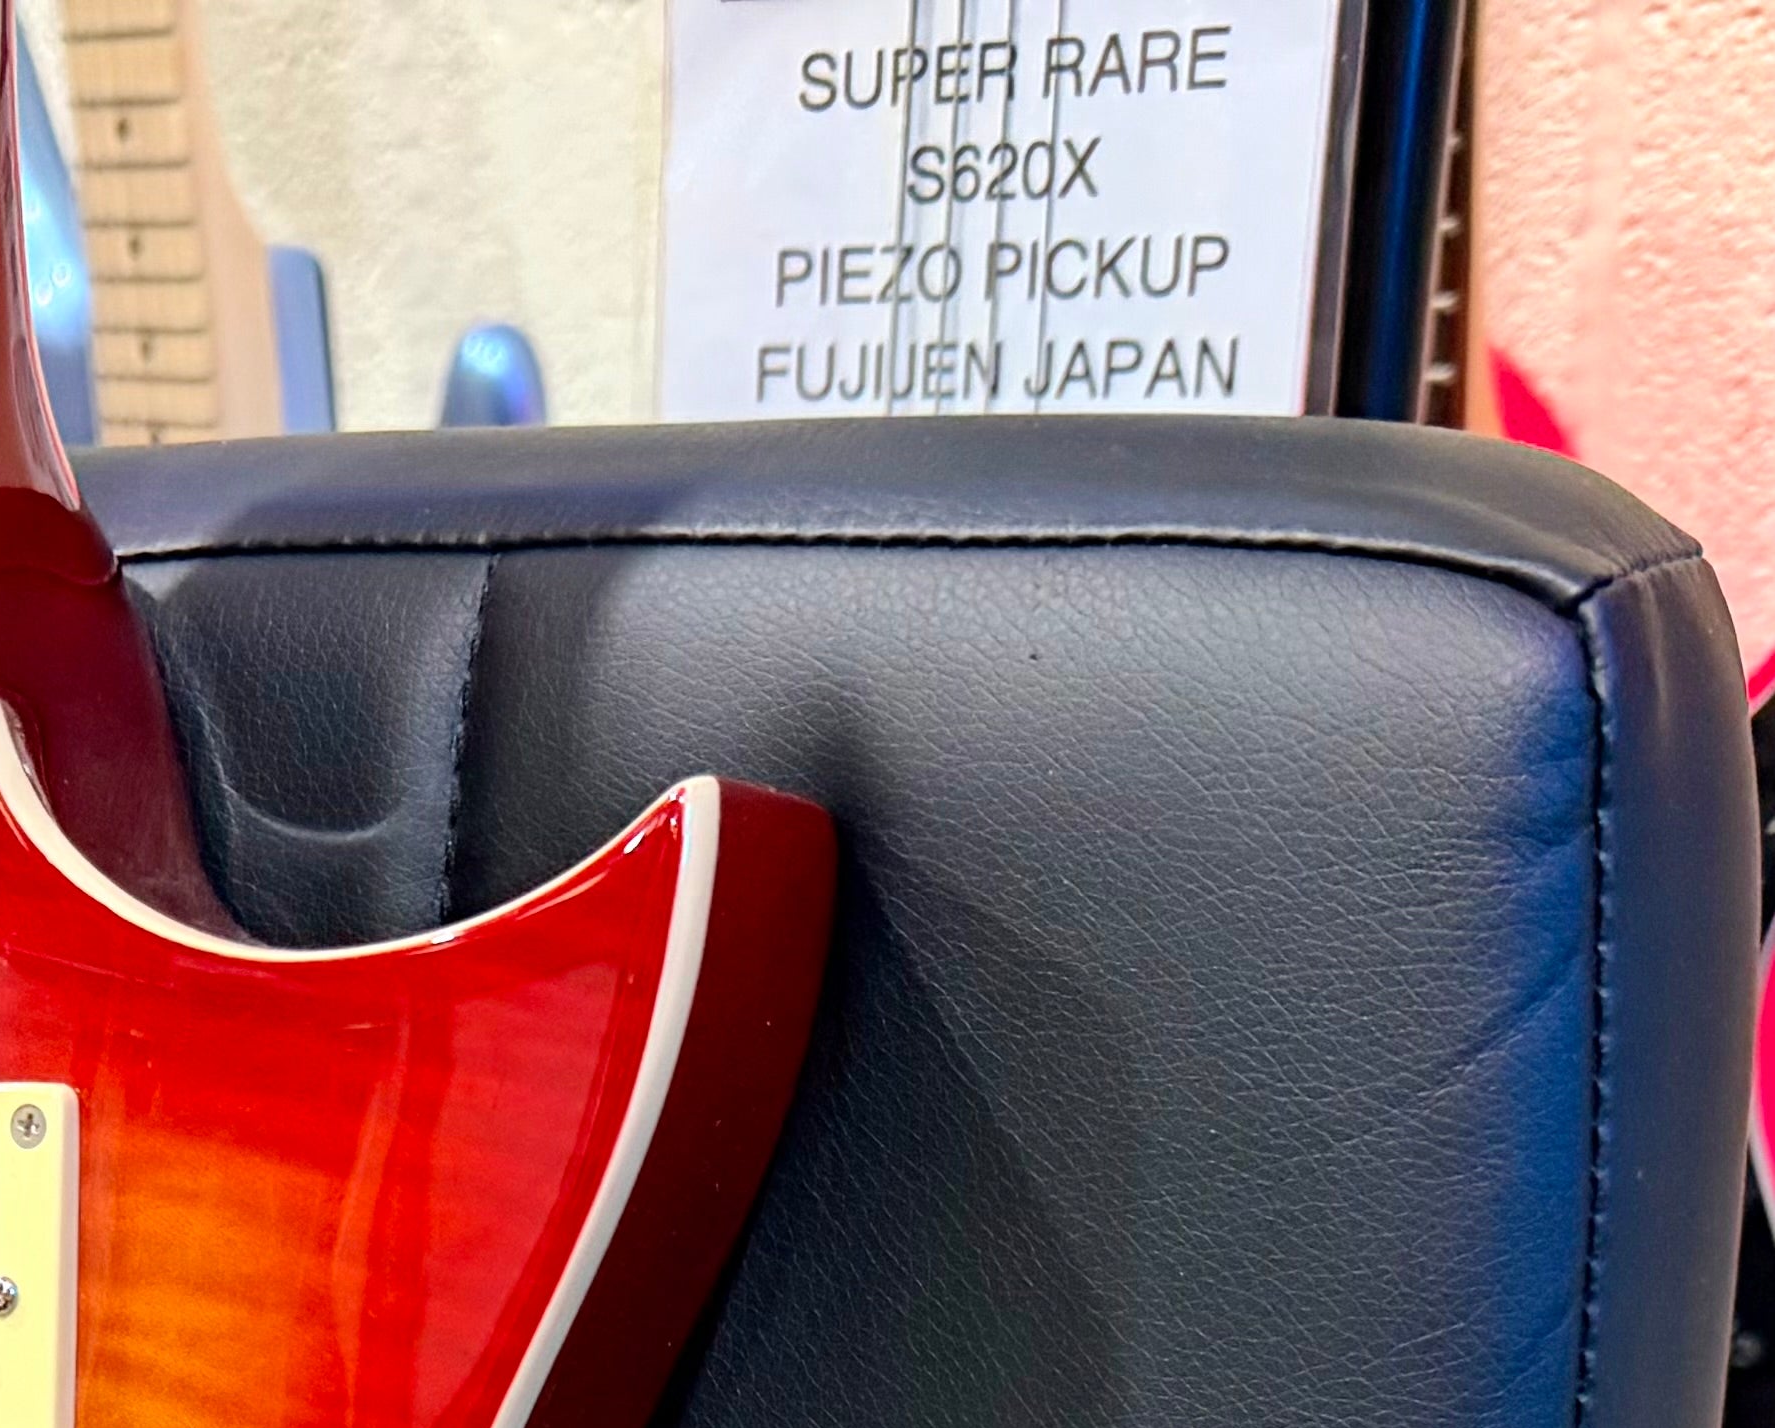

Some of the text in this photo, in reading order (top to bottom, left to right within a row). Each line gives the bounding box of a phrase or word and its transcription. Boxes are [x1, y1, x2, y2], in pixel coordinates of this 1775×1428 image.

[798, 25, 1232, 113] SUPER RARE
[905, 137, 1102, 205] S620X
[774, 234, 1230, 307] PIEZO PICKUP
[1024, 336, 1240, 401] JAPAN
